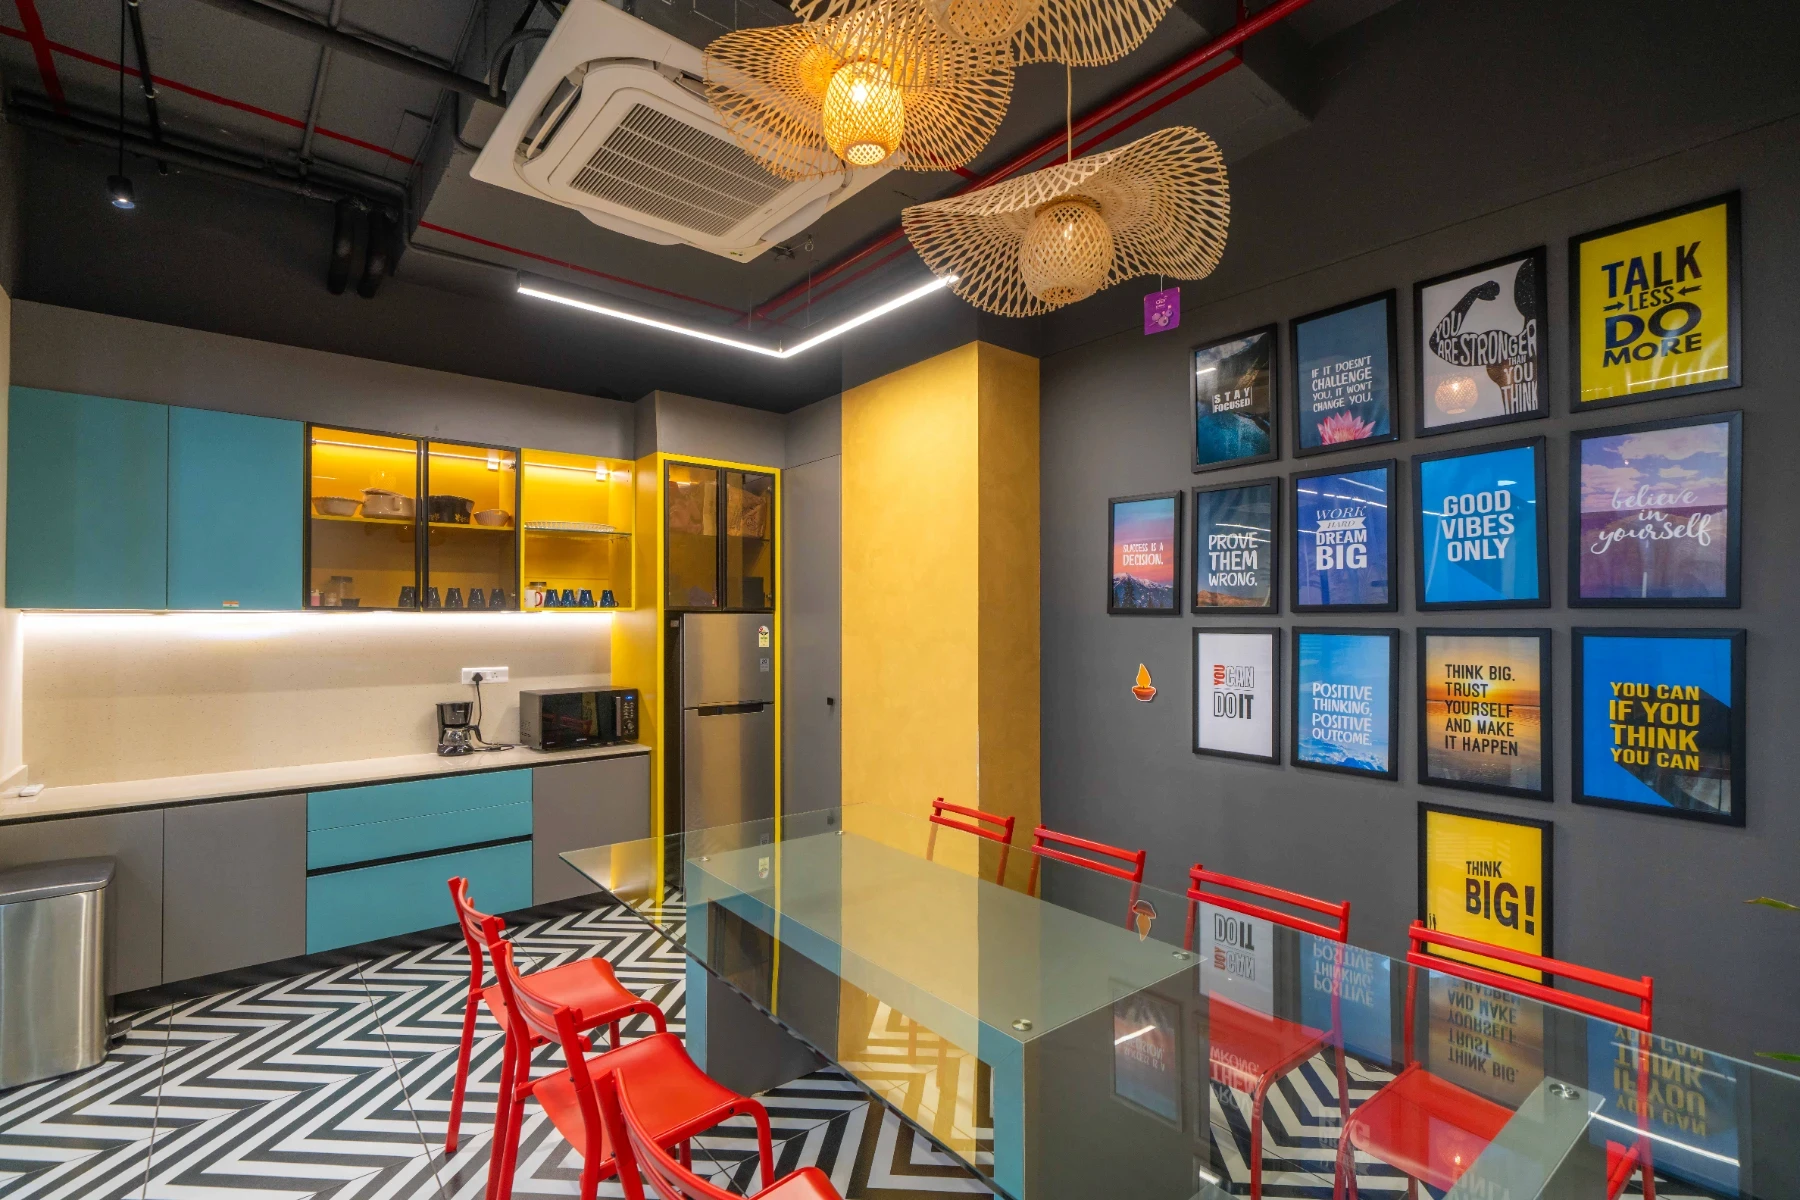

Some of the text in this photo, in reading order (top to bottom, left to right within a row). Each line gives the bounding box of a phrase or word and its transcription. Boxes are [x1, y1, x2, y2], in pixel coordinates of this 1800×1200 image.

[1601, 241, 1702, 299] TALK
[1628, 286, 1675, 312] LESS
[1436, 310, 1462, 342] YOU
[1605, 301, 1702, 349] DO
[1438, 319, 1537, 366] ARE STRONGER
[1602, 332, 1702, 368] MORE
[1311, 355, 1371, 378] IF IT DOESN'T
[1508, 355, 1527, 366] THAN
[1312, 366, 1372, 392] CHALLENGE
[1504, 361, 1533, 384] YOU
[1214, 386, 1251, 404] STAY
[1335, 387, 1343, 397] IT
[1346, 380, 1372, 394] WON'T
[1501, 380, 1538, 415] THINK
[1214, 397, 1251, 413] FOCUSED
[1312, 391, 1373, 413] CHANGE YOU.
[1443, 489, 1511, 517] GOOD
[1611, 484, 1698, 509] believe
[1316, 505, 1367, 520] WORK
[1638, 509, 1668, 522] in
[1327, 520, 1356, 529] HARD
[1441, 513, 1515, 540] VIBES
[1590, 512, 1711, 555] yourself
[1159, 541, 1164, 552] A
[1208, 531, 1258, 551] PROVE
[1316, 529, 1367, 546] DREAM
[1122, 553, 1164, 567] DECISION.
[1208, 549, 1258, 571] THEM
[1316, 543, 1367, 571] BIG
[1447, 537, 1511, 562] ONLY
[1208, 571, 1258, 587] WRONG.
[1213, 664, 1255, 689] YOU CAN
[1444, 663, 1515, 682] THINK BIG.
[1312, 682, 1373, 701] POSITIVE
[1444, 681, 1489, 699] TRUST
[1609, 681, 1700, 702] YOU CAN
[1213, 691, 1254, 720] DO IT
[1444, 699, 1515, 719] YOURSELF
[1608, 699, 1700, 728] IF YOU
[1312, 712, 1373, 733] POSITIVE
[1445, 717, 1515, 738] AND MAKE
[1312, 727, 1373, 746] OUTCOME.
[1444, 734, 1518, 757] IT HAPPEN
[1609, 723, 1700, 754] THINK
[1609, 747, 1700, 772] YOU CAN
[1465, 860, 1503, 879] THINK
[1465, 877, 1536, 937] BIG!
